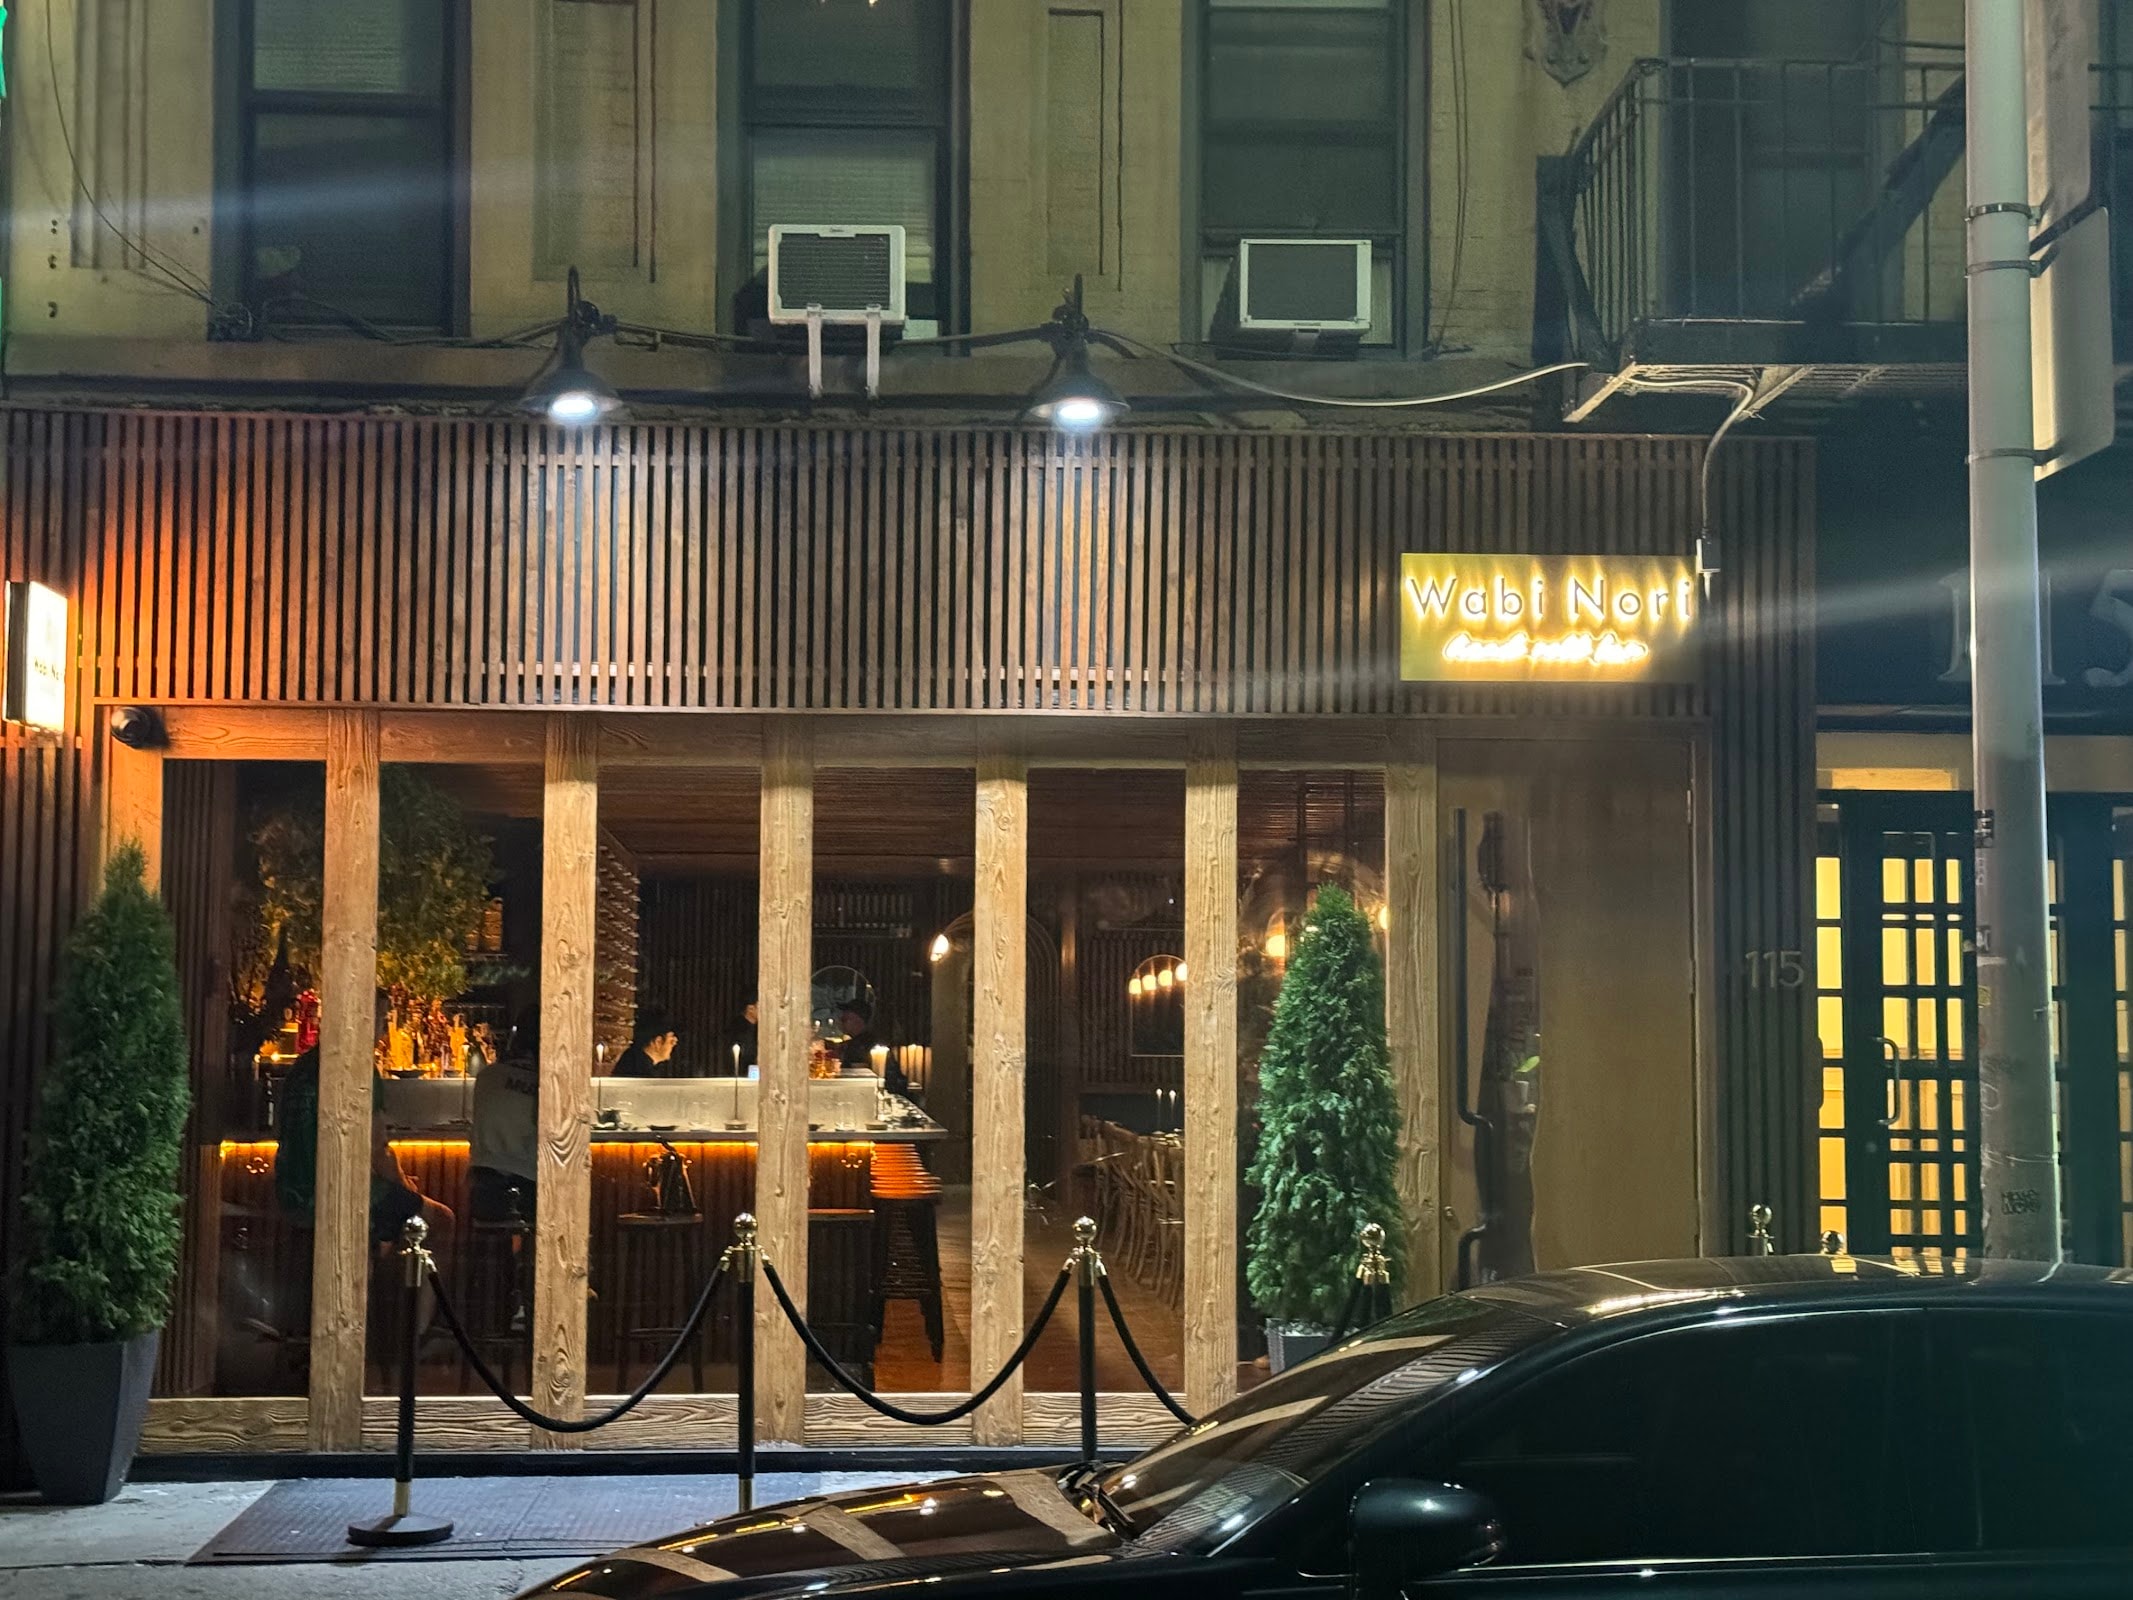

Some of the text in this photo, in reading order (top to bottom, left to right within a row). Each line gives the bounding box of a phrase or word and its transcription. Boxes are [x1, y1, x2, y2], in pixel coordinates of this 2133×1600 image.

[1409, 577, 1694, 617] Wabi Nori
[1745, 949, 1805, 989] 115
